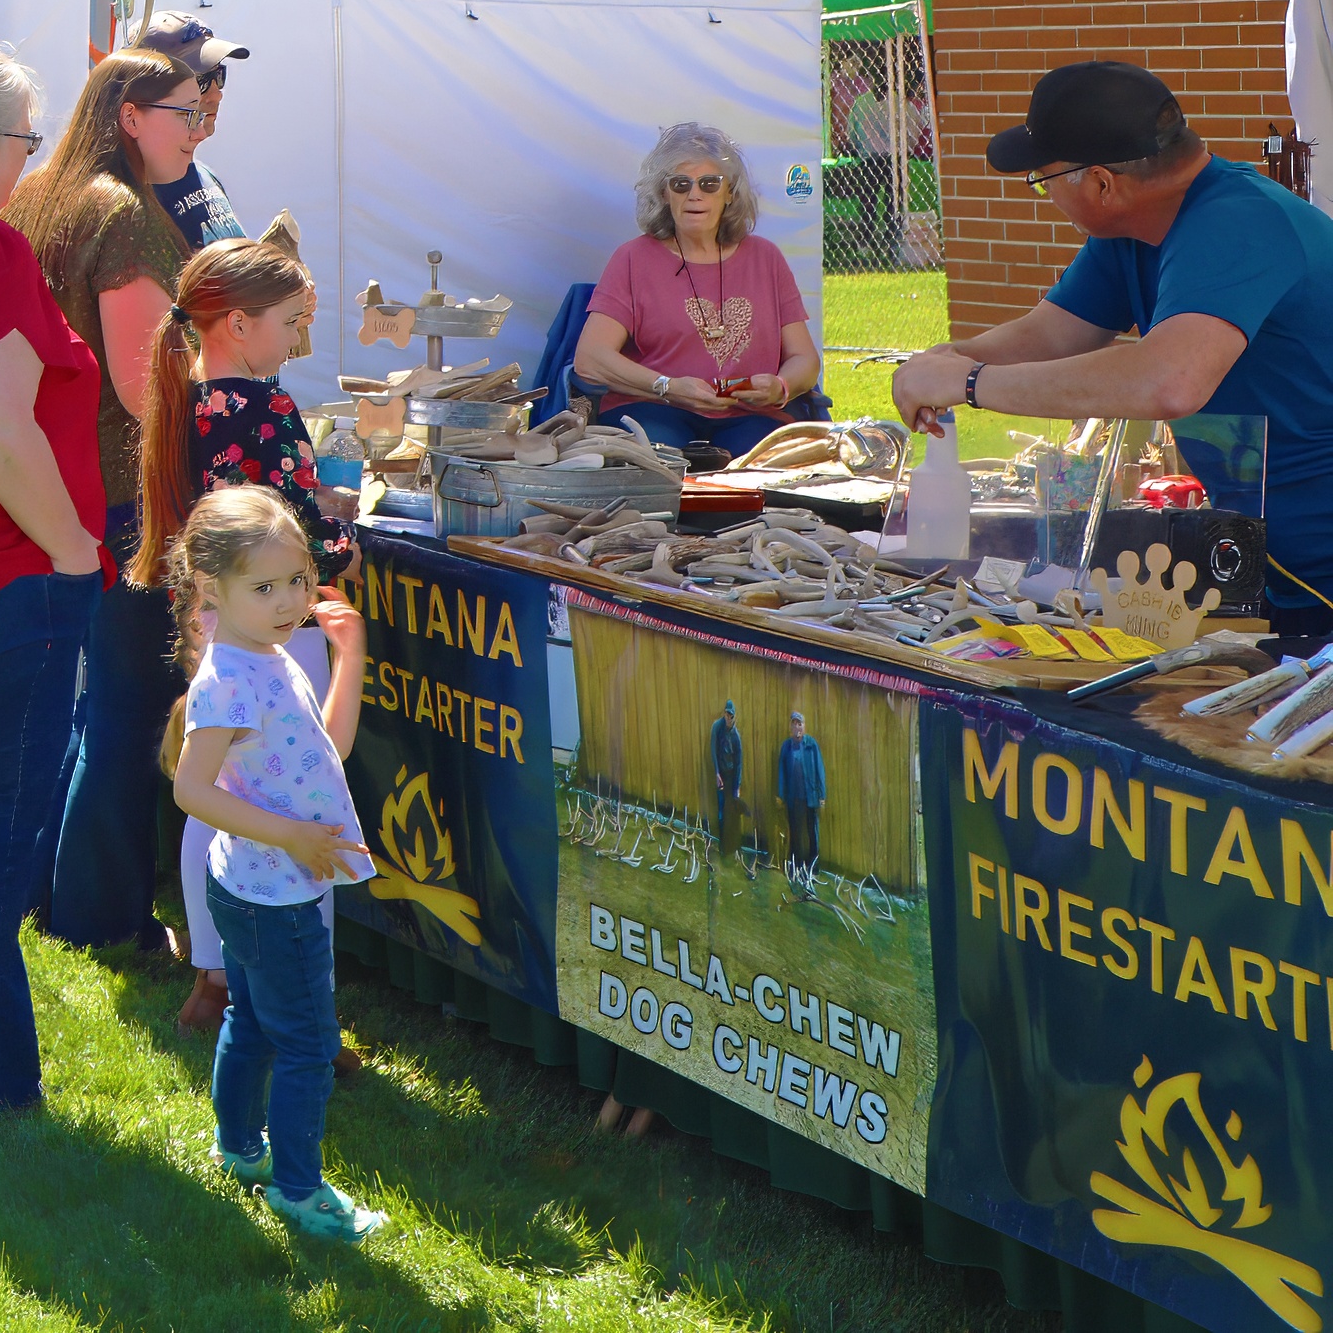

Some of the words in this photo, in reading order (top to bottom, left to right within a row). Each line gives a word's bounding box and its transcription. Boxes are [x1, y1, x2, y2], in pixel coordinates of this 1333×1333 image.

[337, 558, 523, 668] NTANA
[361, 654, 526, 764] ESTARTER
[590, 902, 901, 1077] BELLA-CHEW
[969, 852, 1333, 1051] FIRESTART
[599, 970, 693, 1050] DOG
[713, 1023, 888, 1144] CHEWS
